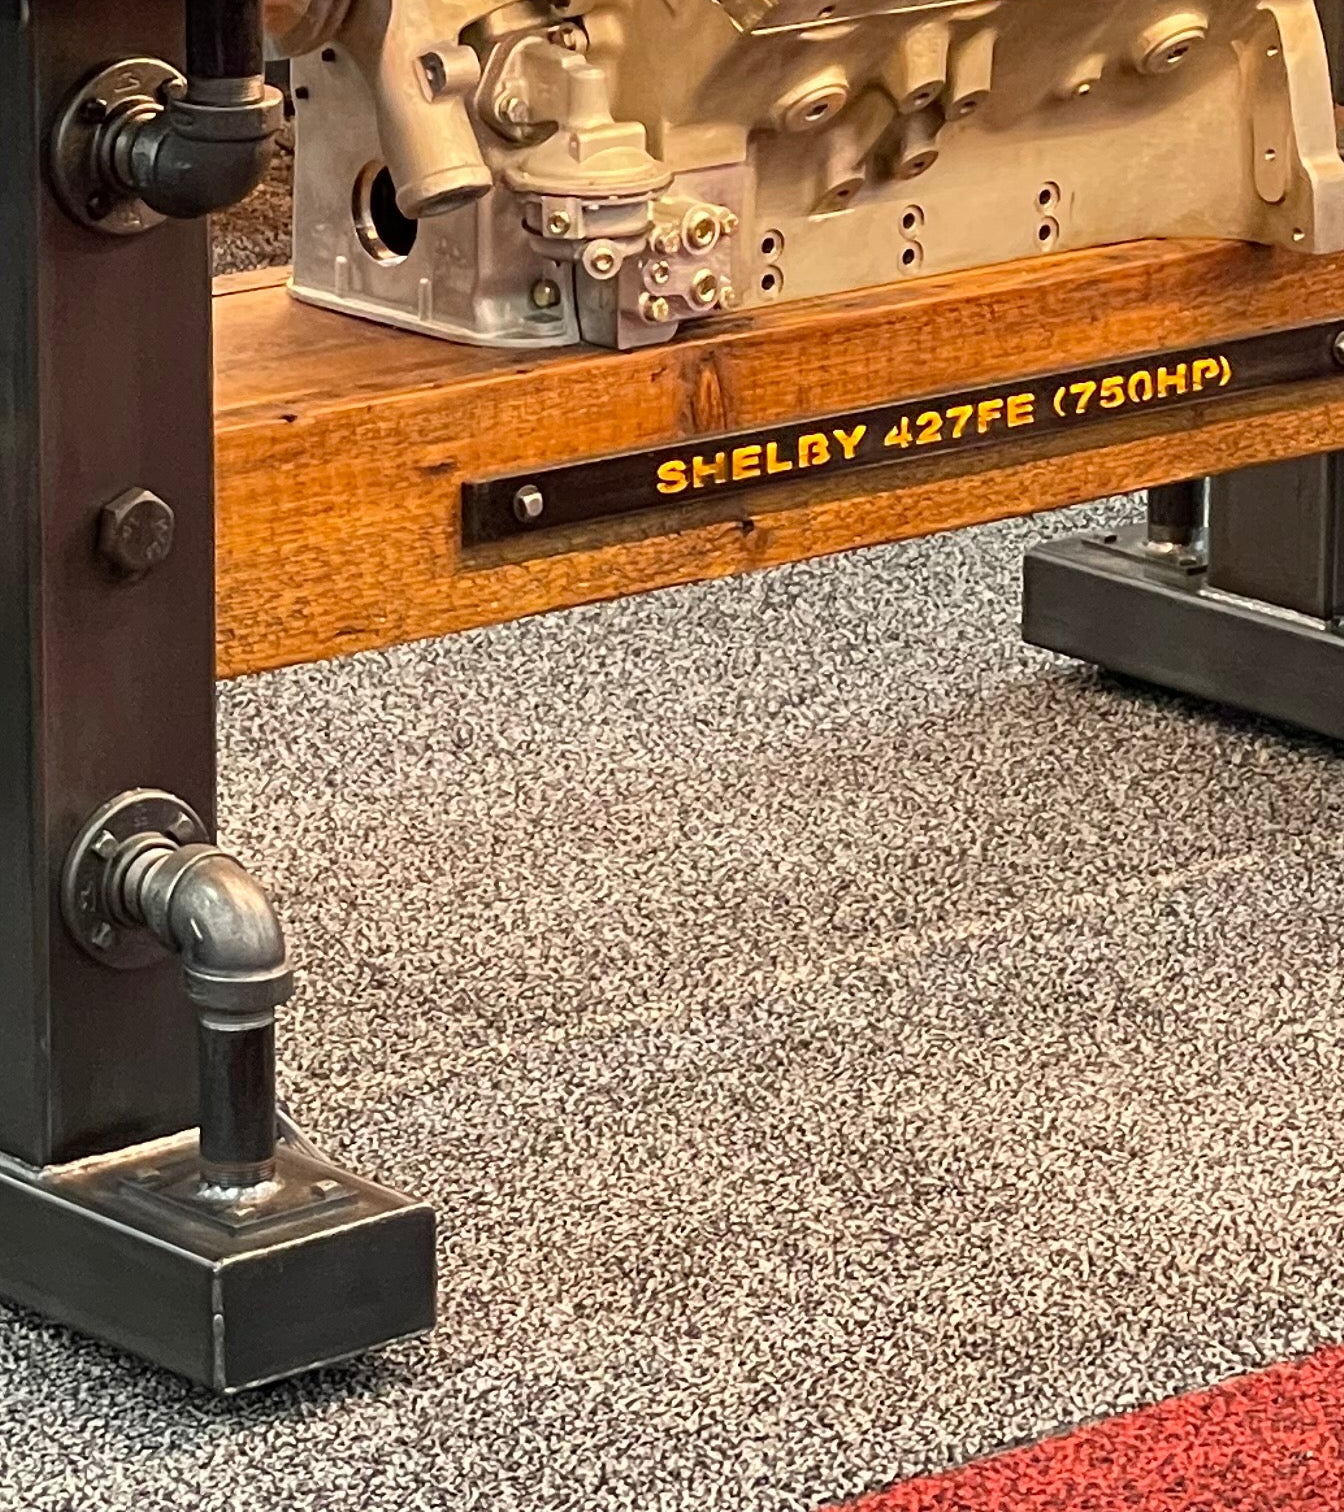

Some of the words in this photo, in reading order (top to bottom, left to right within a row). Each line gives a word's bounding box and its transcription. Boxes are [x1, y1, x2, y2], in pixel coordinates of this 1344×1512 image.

[655, 424, 868, 497] SHELBY
[883, 392, 1036, 451] 427FE
[1052, 354, 1235, 419] (750HP)
